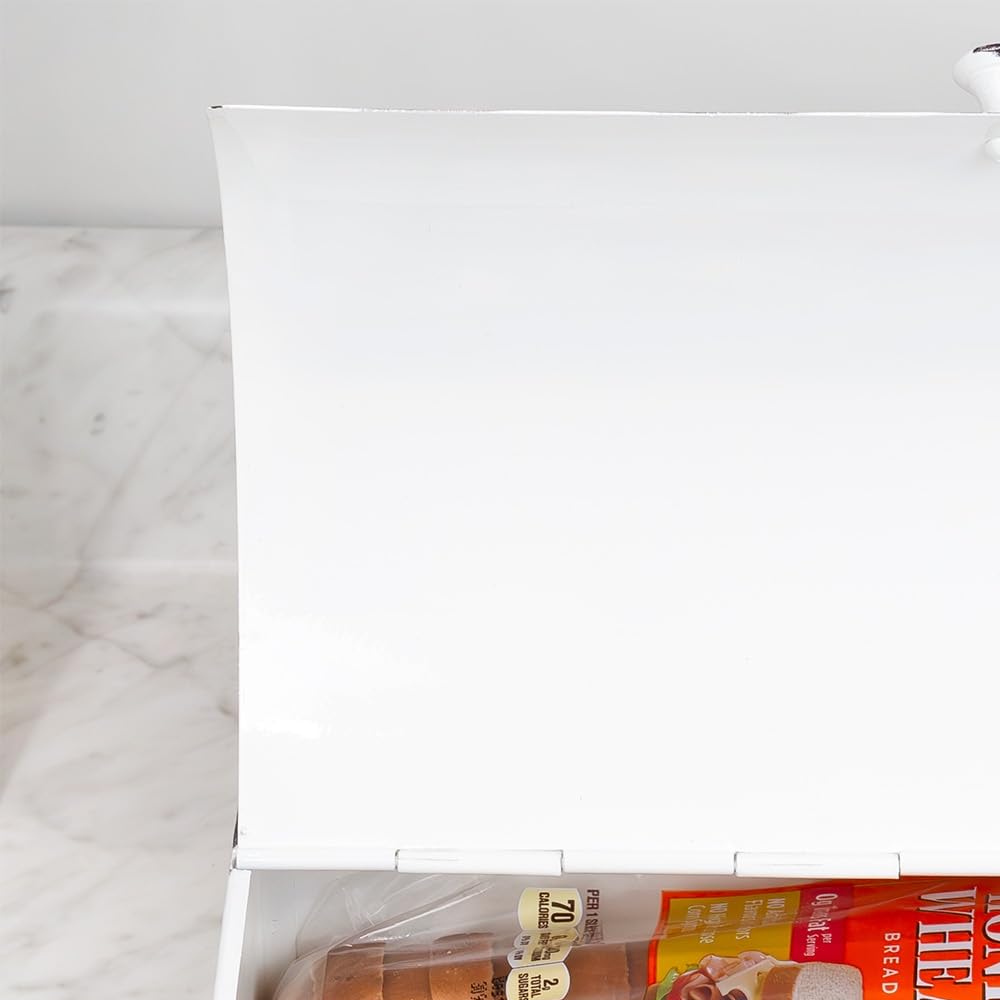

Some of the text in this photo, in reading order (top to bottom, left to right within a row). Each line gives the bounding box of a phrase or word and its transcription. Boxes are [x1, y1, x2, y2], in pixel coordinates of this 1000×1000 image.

[538, 892, 550, 929] CALORIES
[587, 889, 600, 910] PER
[551, 900, 575, 923] 70
[803, 933, 818, 957] Serving
[821, 933, 833, 944] per
[882, 932, 900, 994] BREAD
[531, 974, 541, 998] TOTAL
[542, 978, 559, 991] 2g
